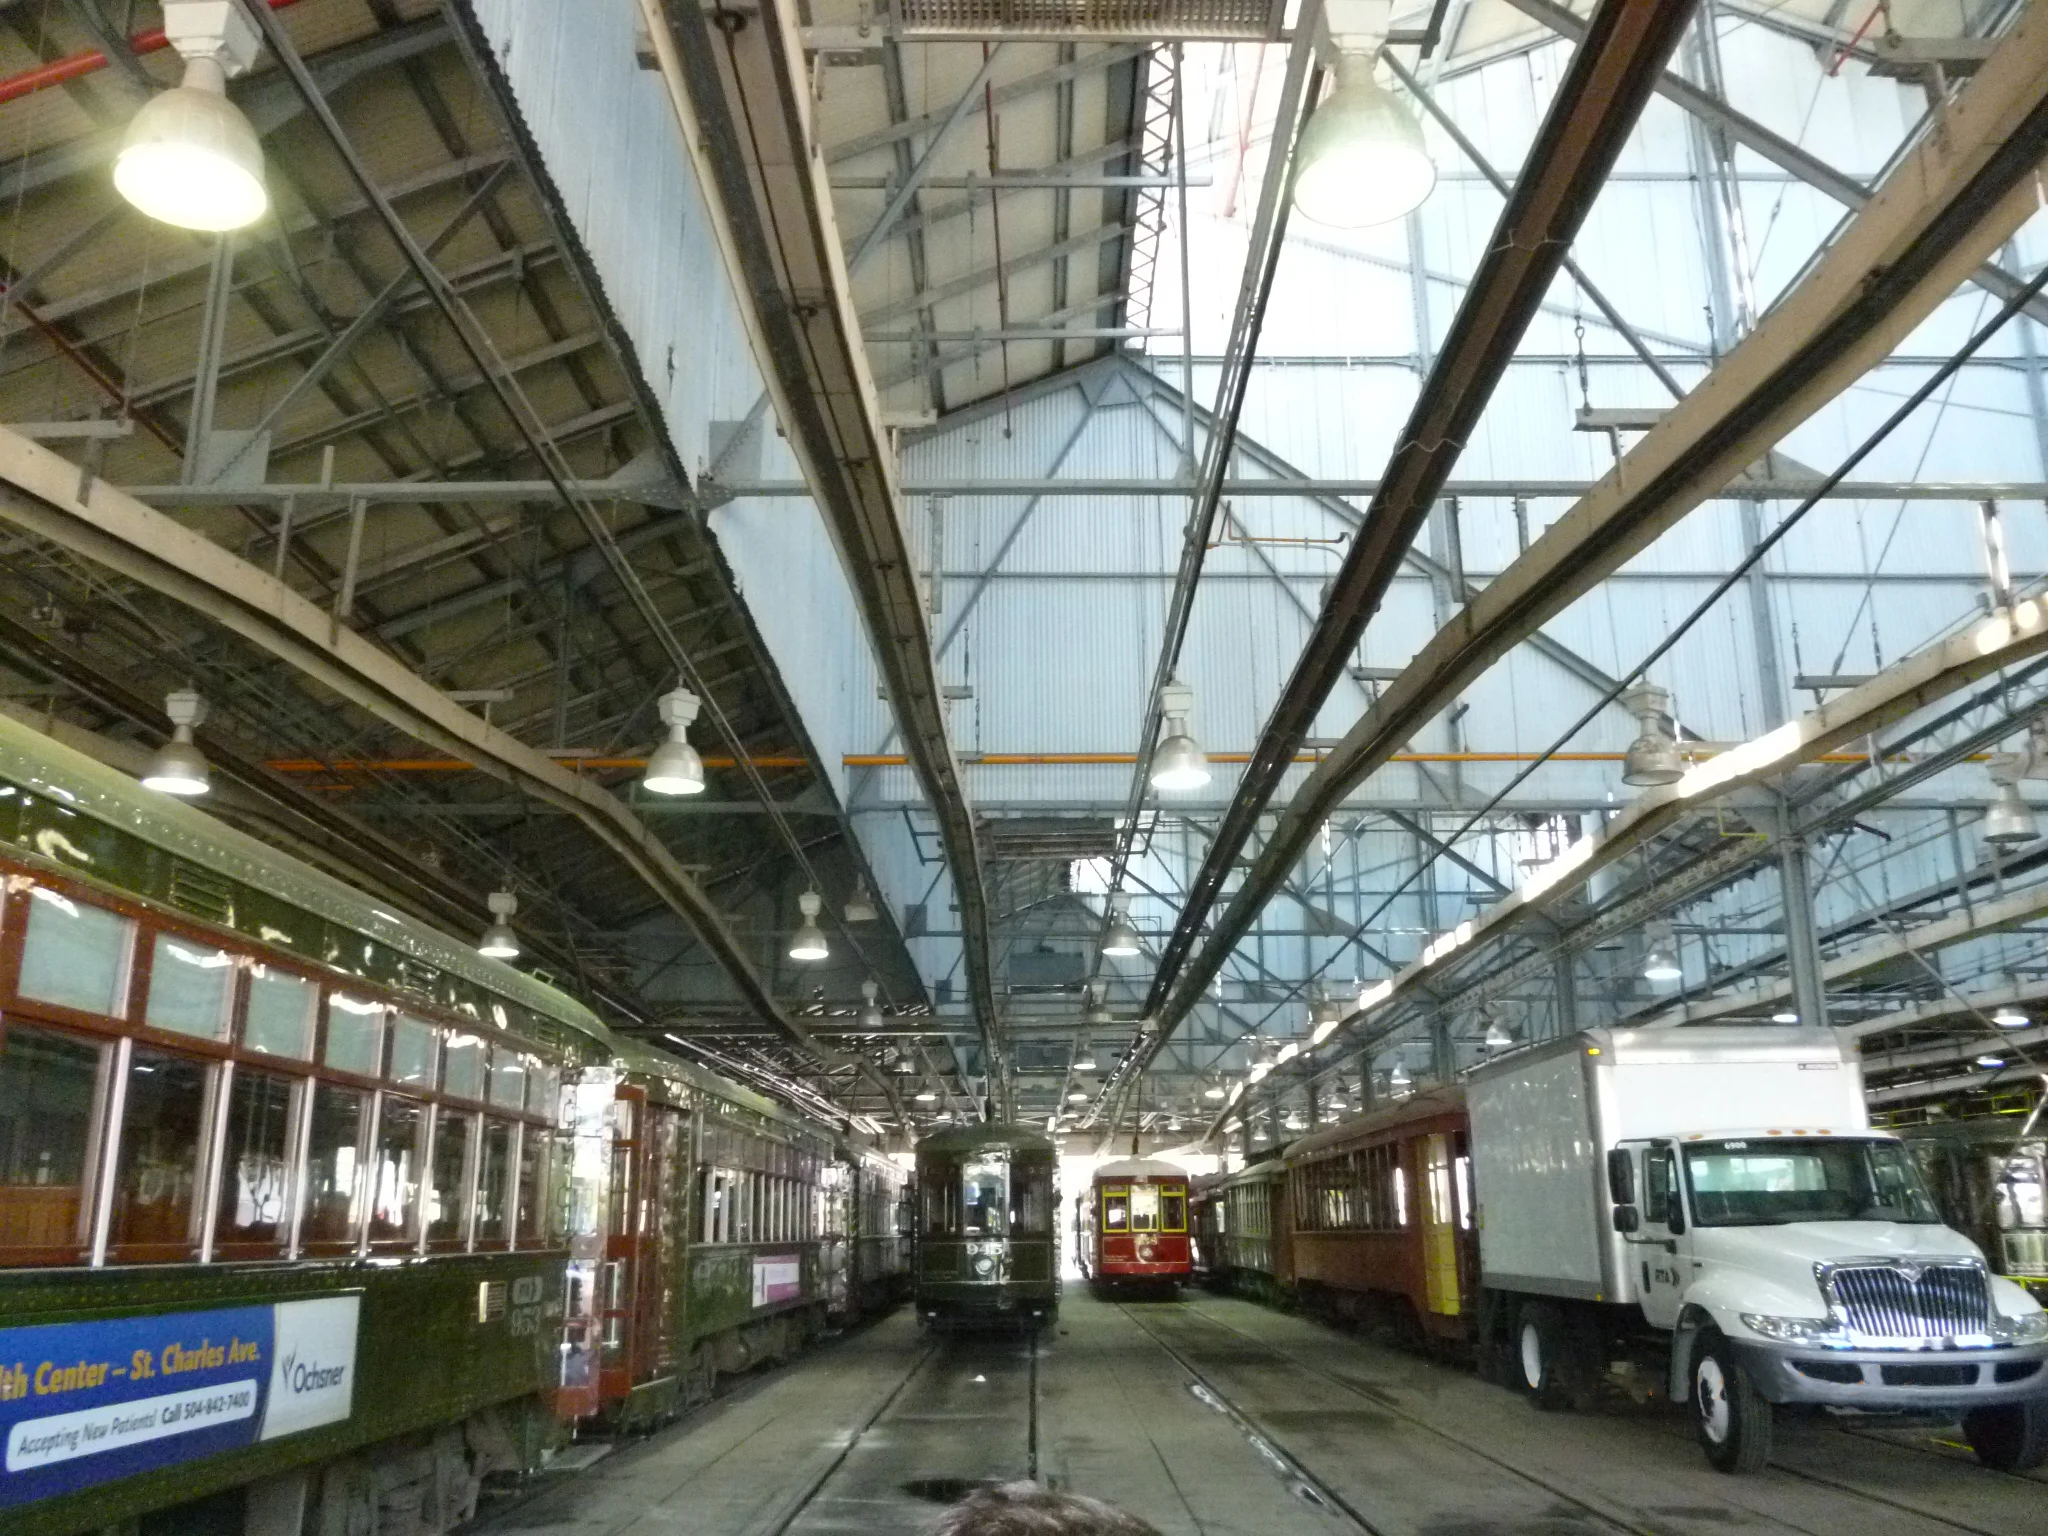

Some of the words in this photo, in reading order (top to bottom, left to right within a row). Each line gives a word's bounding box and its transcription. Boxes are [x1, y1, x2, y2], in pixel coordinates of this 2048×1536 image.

[966, 1242, 1003, 1256] 945
[1655, 1268, 1670, 1283] RTA
[34, 1360, 109, 1395] Center
[129, 1350, 156, 1380] St.
[161, 1339, 225, 1376] Charles
[228, 1337, 260, 1364] Ave.
[294, 1361, 345, 1394] Ochsner
[17, 1427, 79, 1456] Accepting
[82, 1421, 109, 1441] New
[161, 1403, 182, 1425] Call
